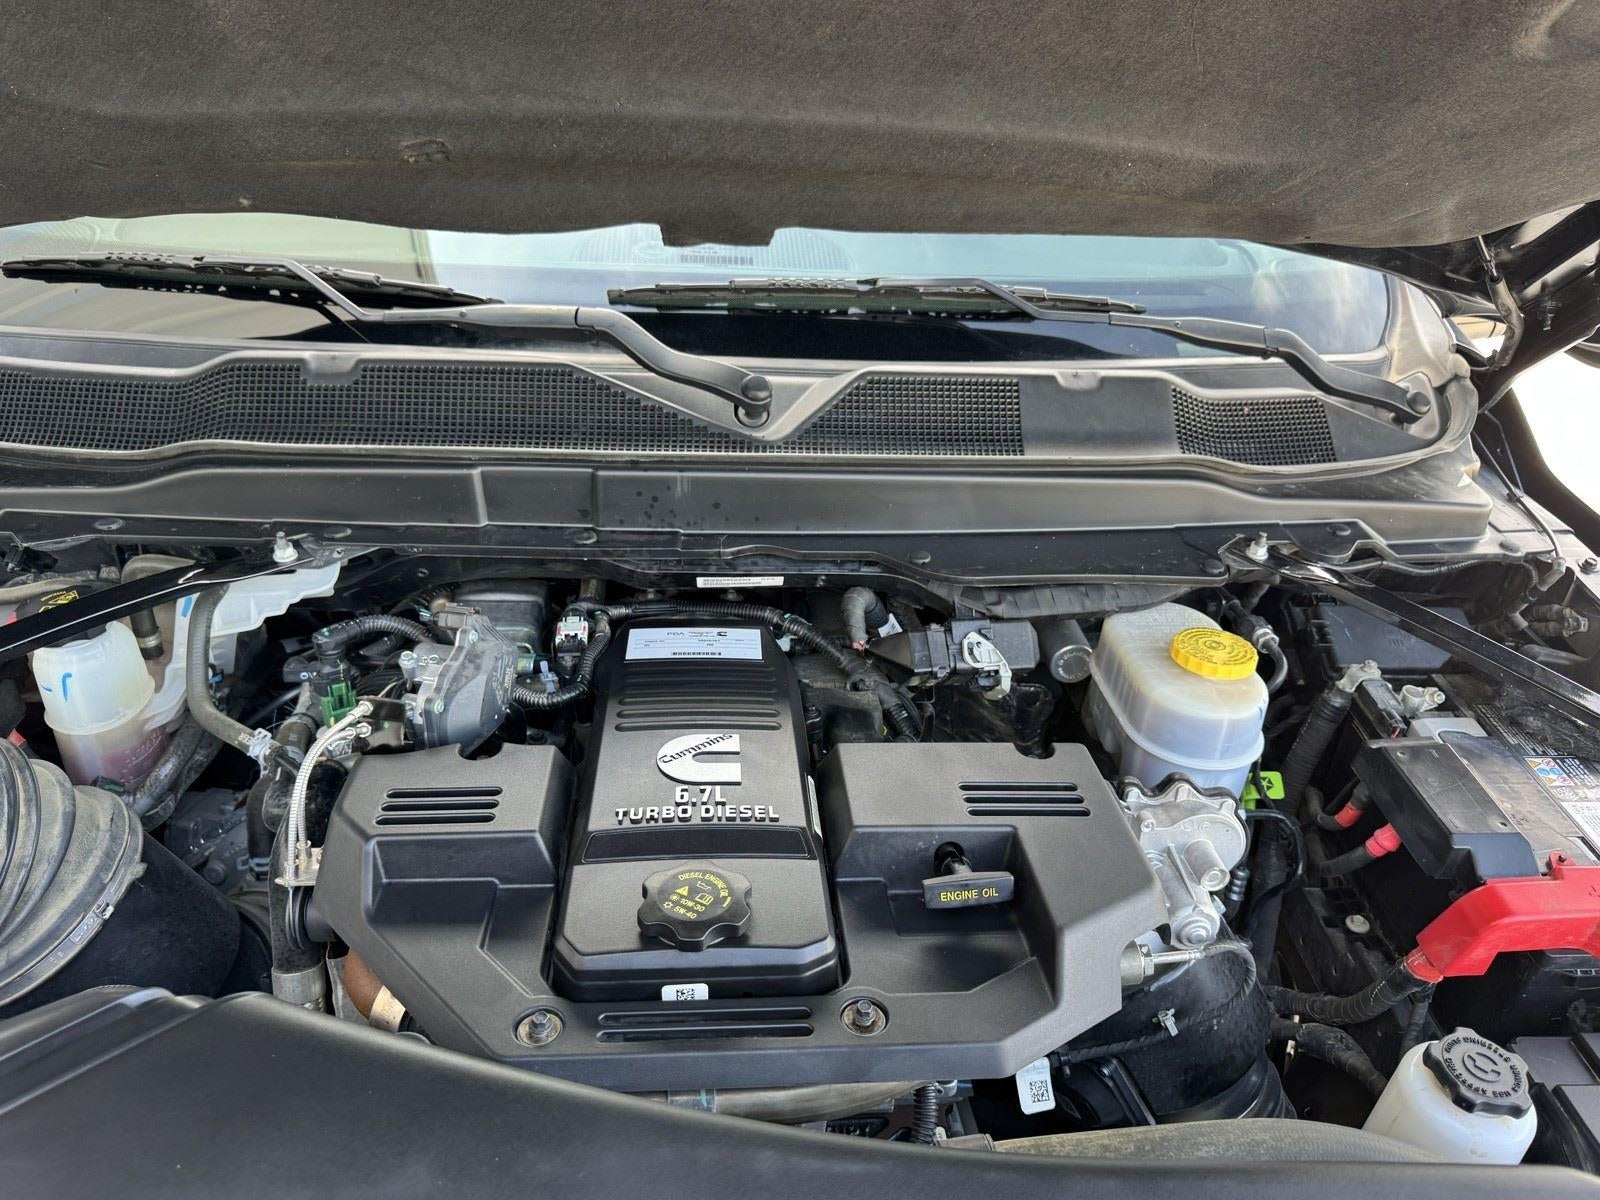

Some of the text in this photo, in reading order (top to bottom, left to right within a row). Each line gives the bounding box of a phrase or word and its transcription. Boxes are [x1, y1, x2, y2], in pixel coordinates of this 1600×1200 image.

[659, 733, 733, 764] Cummins
[674, 785, 727, 805] 6.7L
[615, 804, 780, 824] TURBO DIESEL
[678, 872, 703, 880] DIESEL
[705, 873, 728, 889] ENGINE
[940, 888, 998, 901] ENGINE OIL
[673, 906, 697, 919] 5W-40
[680, 898, 705, 911] 10W-30
